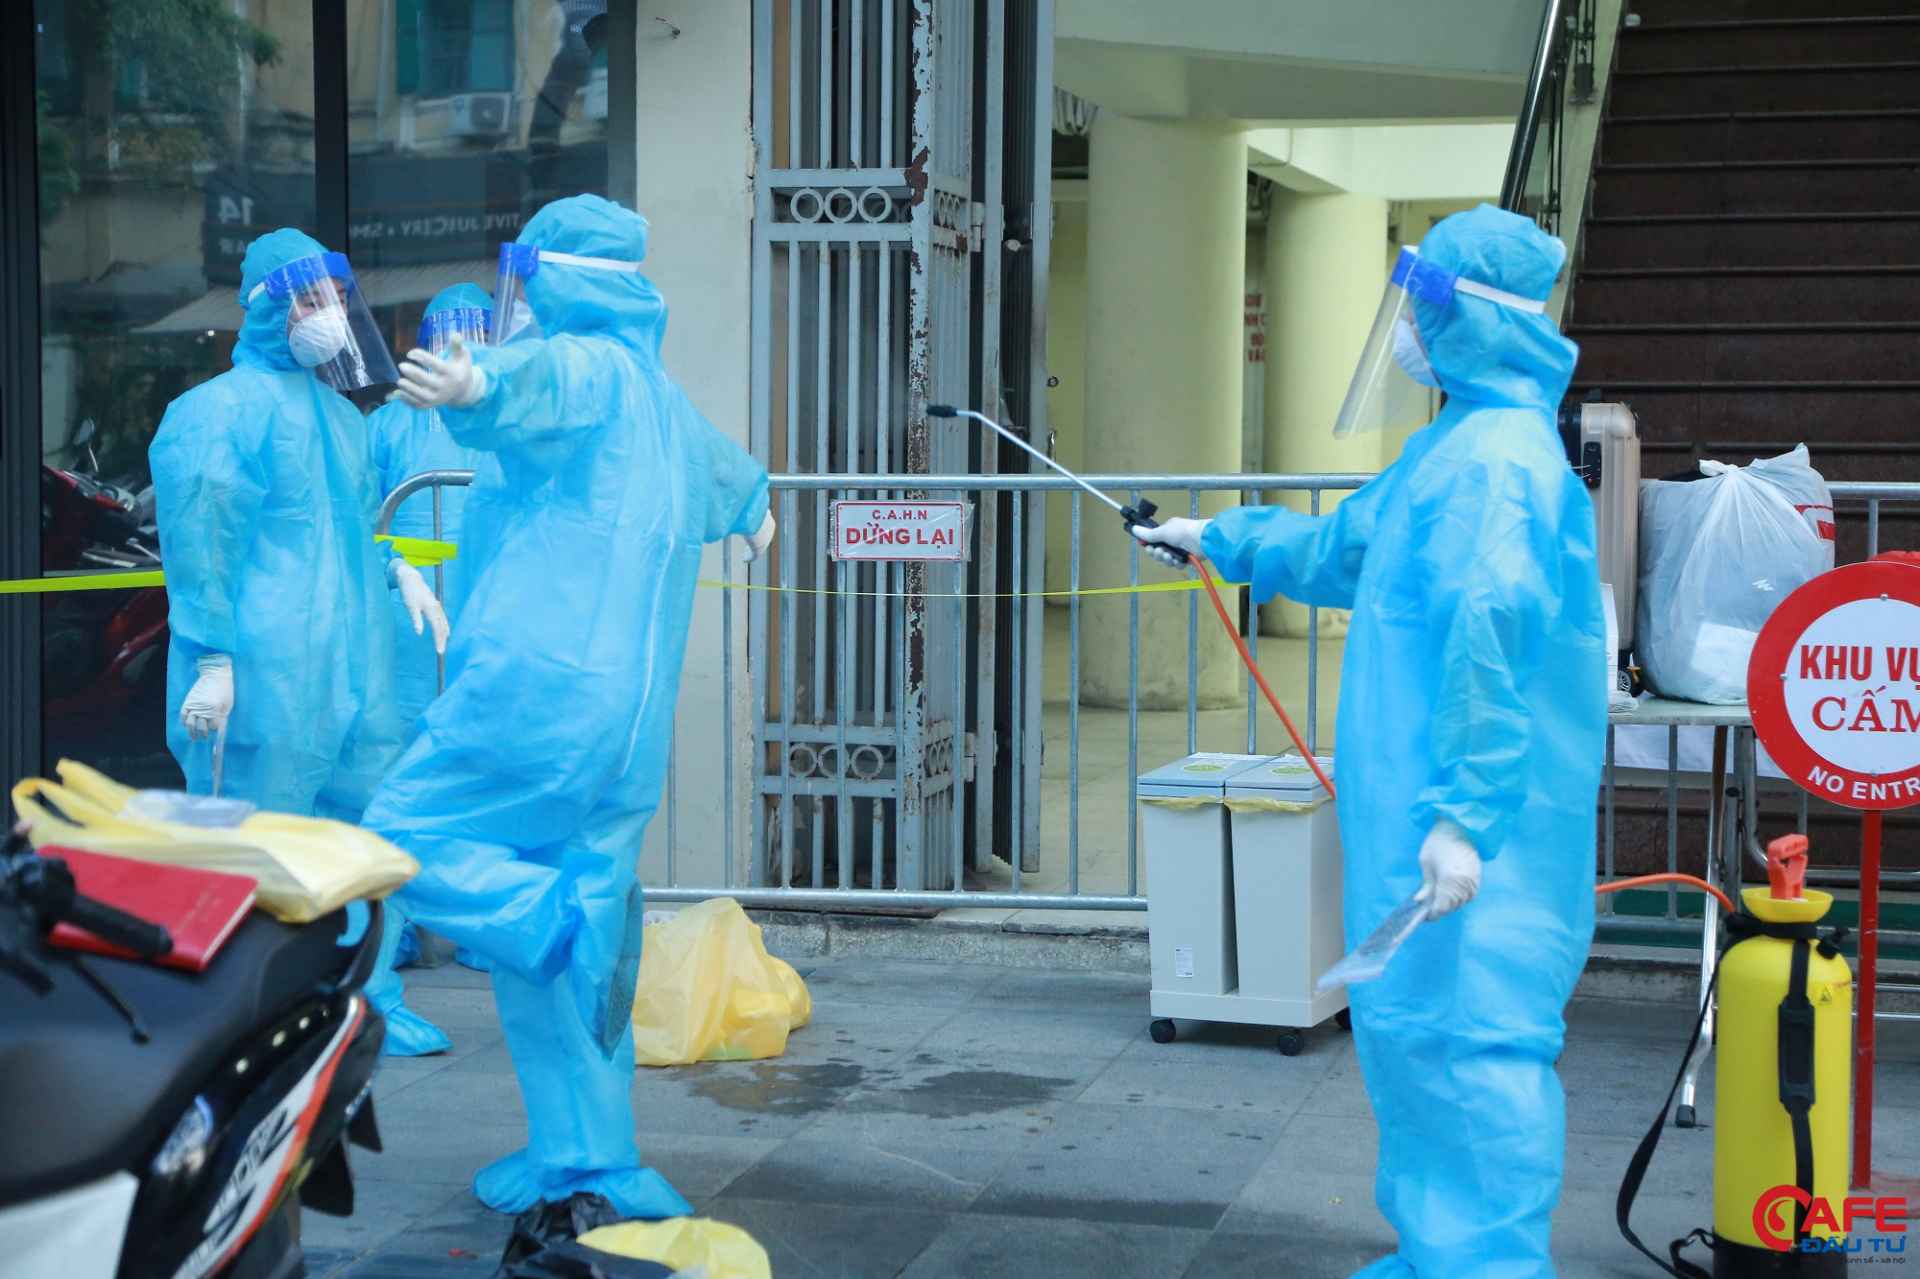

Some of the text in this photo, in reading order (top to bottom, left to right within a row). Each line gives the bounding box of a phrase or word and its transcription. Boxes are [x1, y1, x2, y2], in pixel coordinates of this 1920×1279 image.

[872, 509, 928, 520] C.A.H.N
[846, 522, 953, 548] DỪNG LẠI
[1800, 645, 1873, 681] KHU
[1807, 766, 1844, 793] NO
